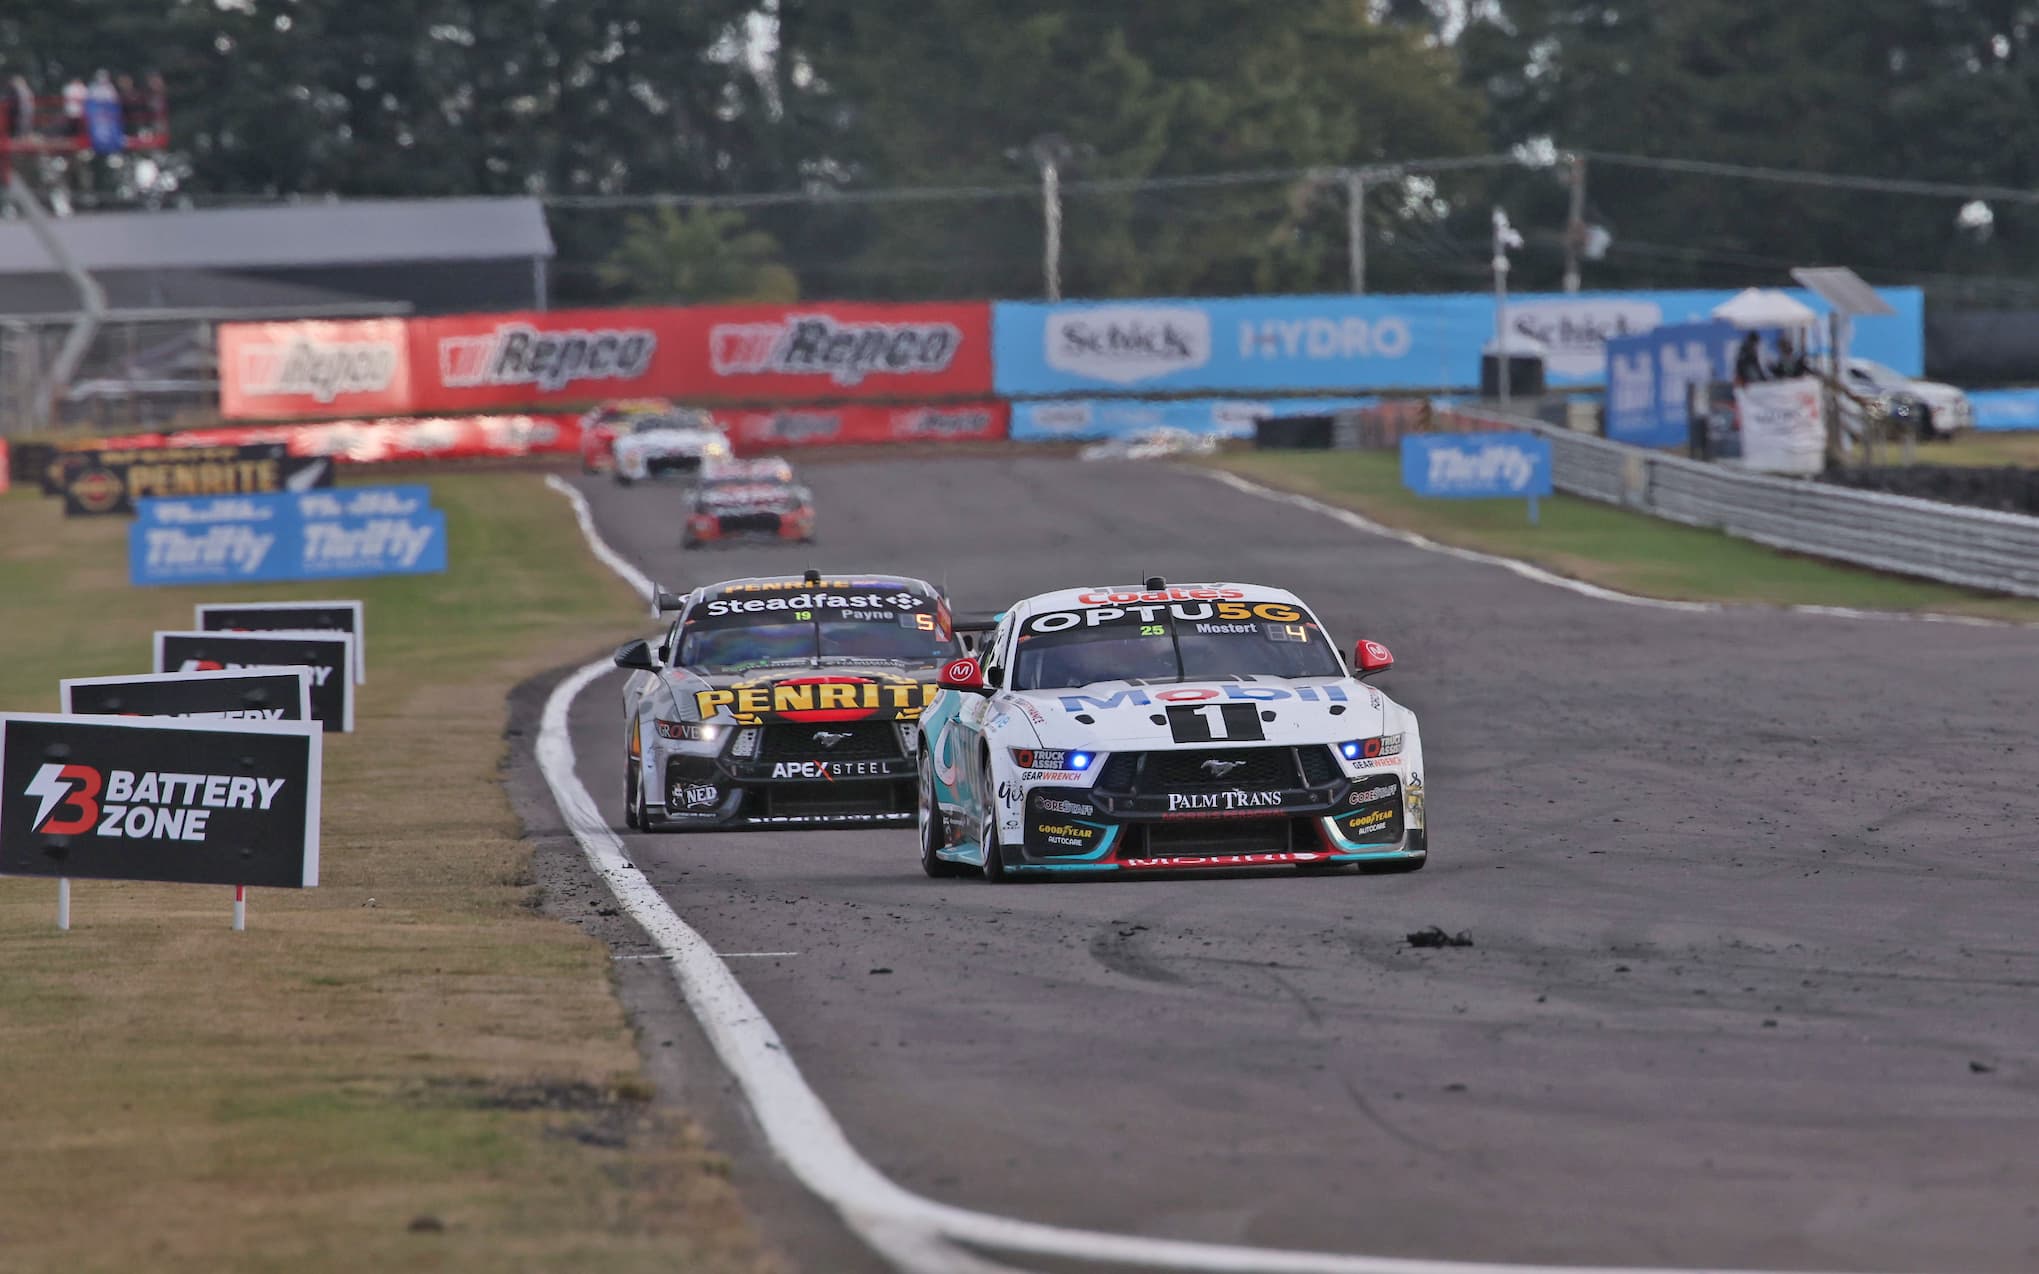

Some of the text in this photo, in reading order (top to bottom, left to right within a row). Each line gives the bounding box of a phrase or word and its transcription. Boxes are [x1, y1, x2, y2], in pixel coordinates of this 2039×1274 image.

[785, 317, 952, 376] Repco
[1061, 319, 1191, 359] Schick
[1240, 316, 1412, 359] HYDRO
[496, 331, 650, 380] Repco
[1428, 446, 1541, 491] Thrifty
[145, 525, 276, 574] Thrifty
[302, 518, 435, 568] Thrifty
[707, 592, 884, 616] Steadfast
[1077, 588, 1244, 606] Coates
[794, 611, 812, 621] 19
[842, 608, 894, 621] Payne
[1139, 625, 1165, 636] 25
[1195, 623, 1258, 635] Mostert
[1284, 624, 1308, 643] 4
[1059, 684, 1349, 712] Mobil
[1192, 704, 1229, 739] 1
[1031, 760, 1064, 769] ASSIST
[1034, 750, 1065, 760] TRUCK
[772, 760, 891, 781] APEX STEEL
[1021, 771, 1082, 781] GEARWRENCH
[105, 770, 286, 810] BATTERY
[686, 786, 718, 804] NED
[1167, 789, 1282, 811] PALM TRANS
[96, 805, 211, 841] ZONE
[1349, 810, 1393, 828] GOODYEAR
[1039, 824, 1093, 838] GOODYEAR
[1048, 835, 1083, 847] AUTOCARE
